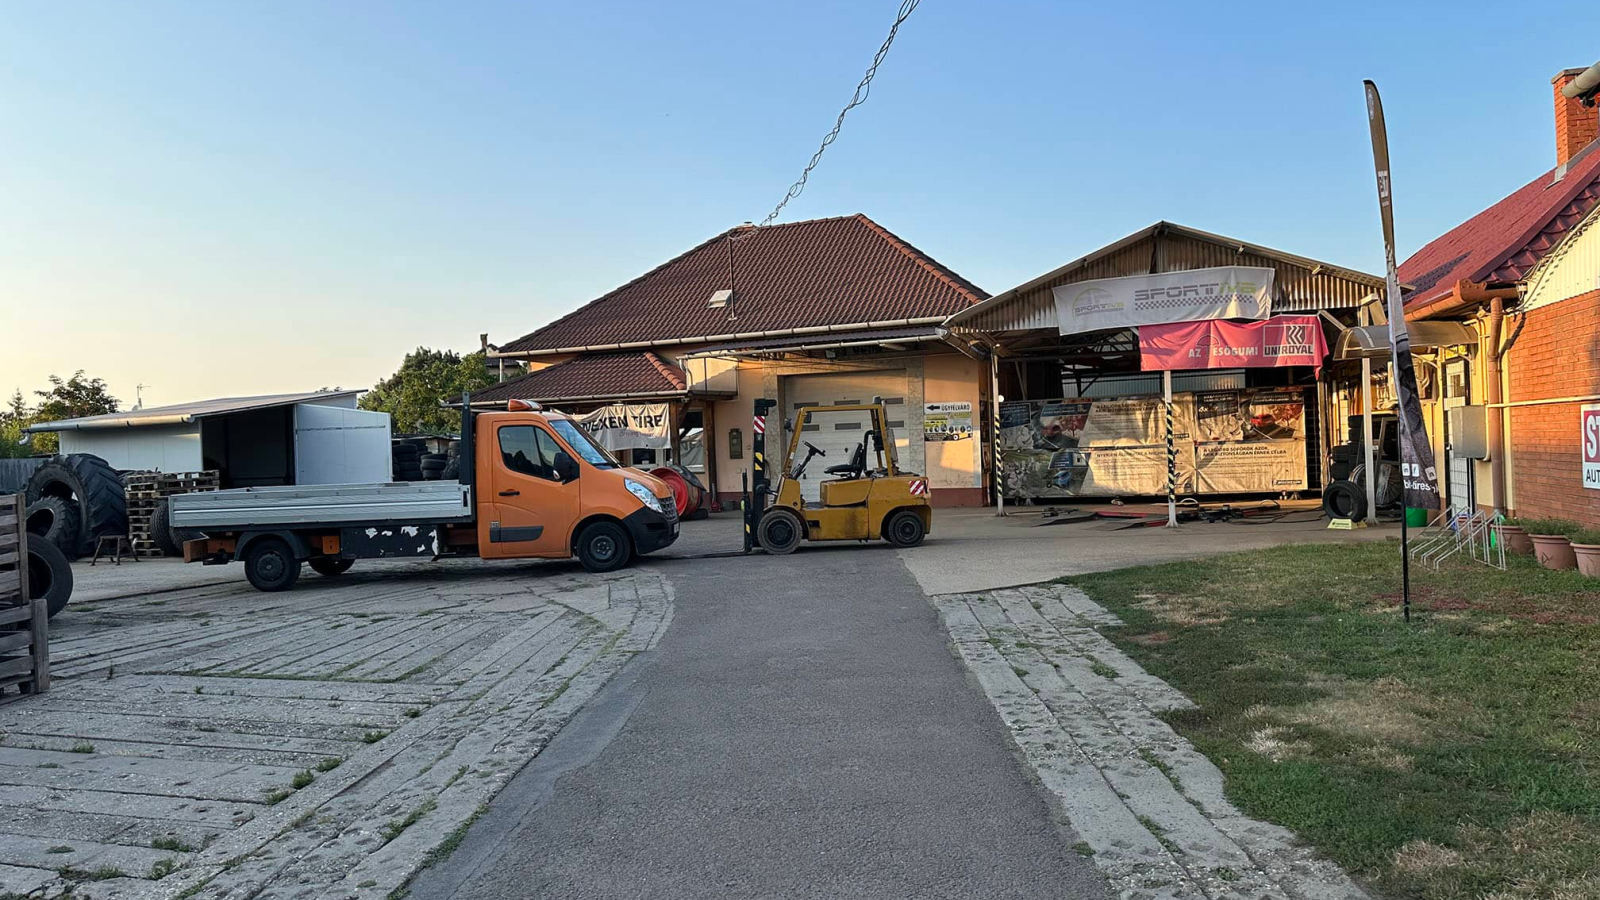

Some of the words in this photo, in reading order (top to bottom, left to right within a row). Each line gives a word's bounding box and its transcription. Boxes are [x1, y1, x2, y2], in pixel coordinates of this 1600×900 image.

[1188, 348, 1201, 358] AZ
[1264, 344, 1313, 356] UNIROYAL
[582, 415, 628, 432] NEXEN
[631, 414, 663, 428] TIRE
